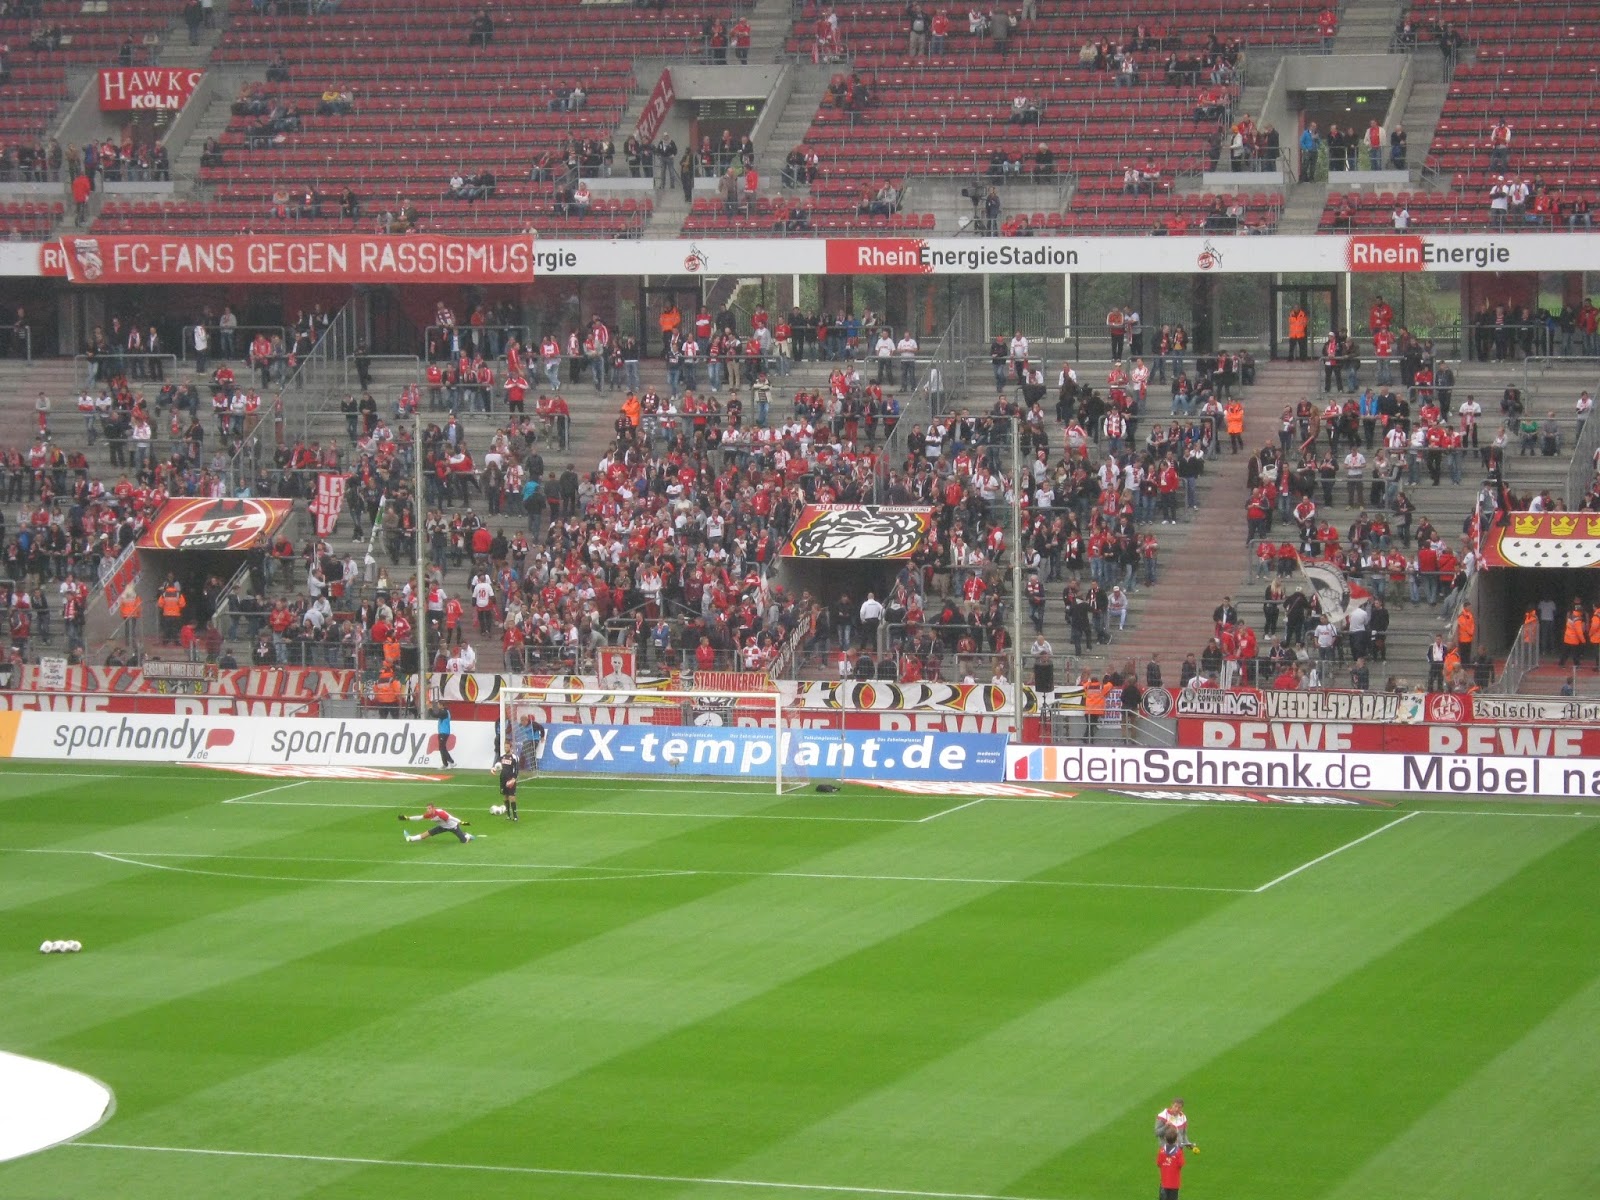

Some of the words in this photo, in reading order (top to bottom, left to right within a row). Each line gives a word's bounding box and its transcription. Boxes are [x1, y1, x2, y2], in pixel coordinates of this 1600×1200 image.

[131, 91, 178, 108] KÖLN
[114, 243, 234, 273] FC-FANS
[247, 243, 346, 273] GEGEN
[361, 242, 527, 274] RASSISMUS
[857, 246, 1078, 269] RheinEnergieStadion
[1353, 243, 1510, 268] RheinEnergie
[181, 534, 231, 547] KÖLN
[453, 663, 458, 672] 9
[694, 671, 767, 691] STADIONVERBOT
[1475, 701, 1545, 720] Kölsche
[54, 717, 206, 759] sparhandy
[271, 721, 426, 764] sparhandy
[1203, 721, 1353, 750] REWE
[1429, 726, 1583, 757] REWE
[1063, 748, 1372, 789] deinSchrank.de
[1403, 755, 1540, 794] Möbel
